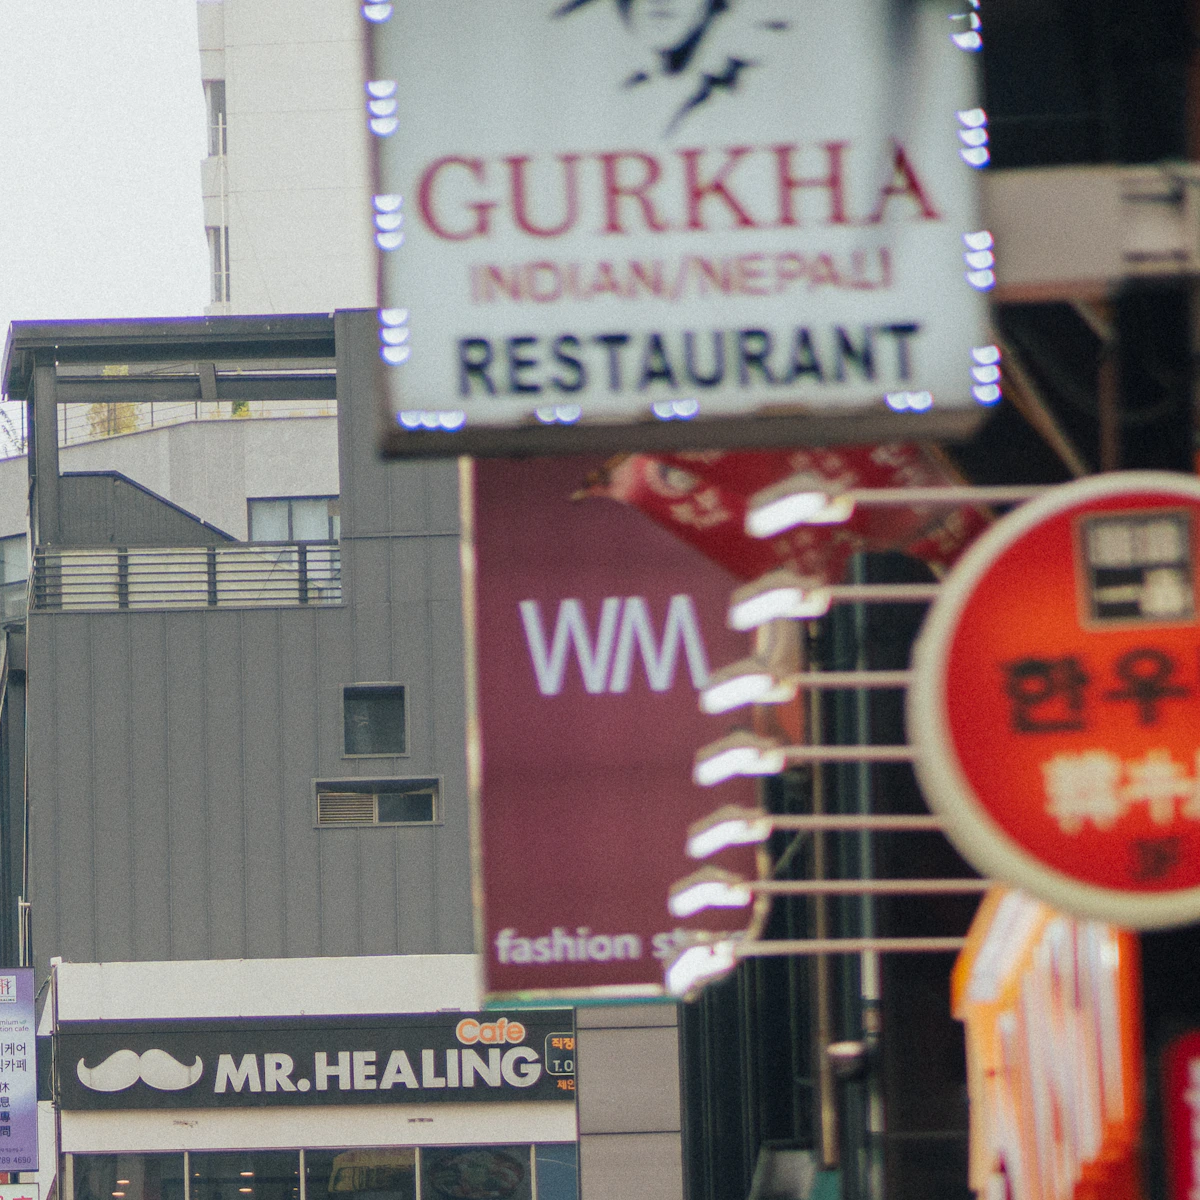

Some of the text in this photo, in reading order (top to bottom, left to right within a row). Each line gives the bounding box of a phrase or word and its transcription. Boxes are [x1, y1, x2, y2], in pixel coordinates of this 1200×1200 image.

[415, 138, 942, 242] GURKHA
[457, 322, 921, 398] RESTAURANT
[495, 927, 641, 963] fashion
[456, 1017, 526, 1045] Cafe
